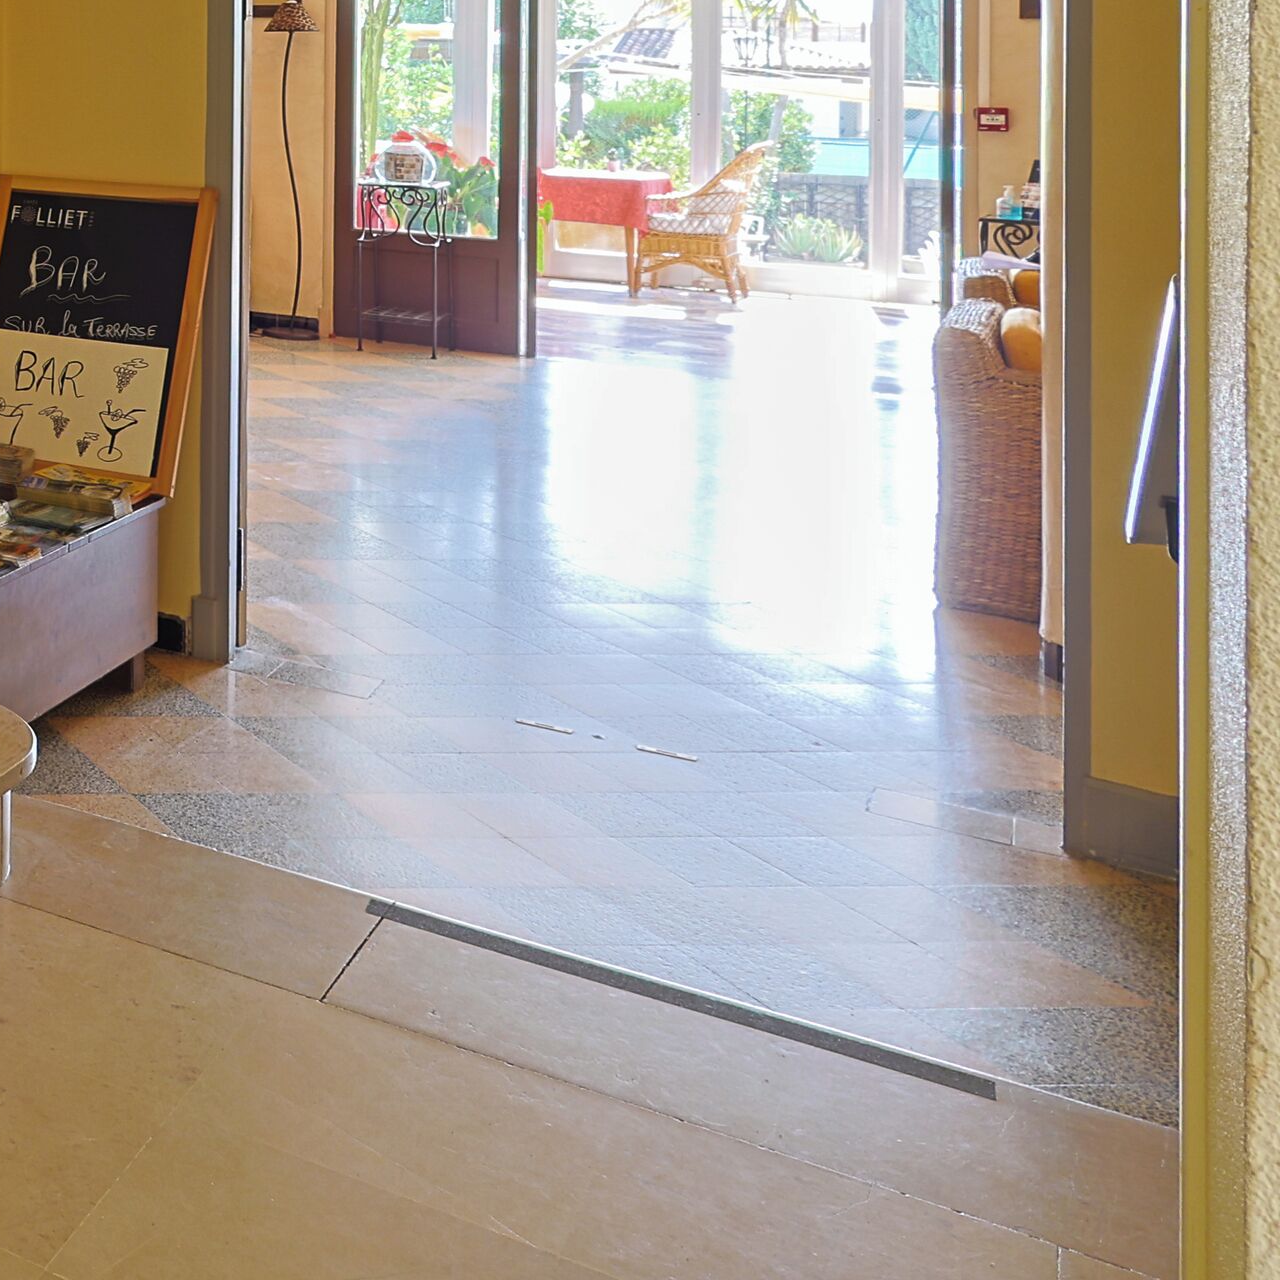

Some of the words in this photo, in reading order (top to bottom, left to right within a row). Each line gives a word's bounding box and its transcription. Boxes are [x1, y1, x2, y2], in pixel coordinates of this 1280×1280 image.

[20, 245, 106, 296] BAR
[4, 315, 46, 334] SUR
[13, 350, 86, 399] BAR
